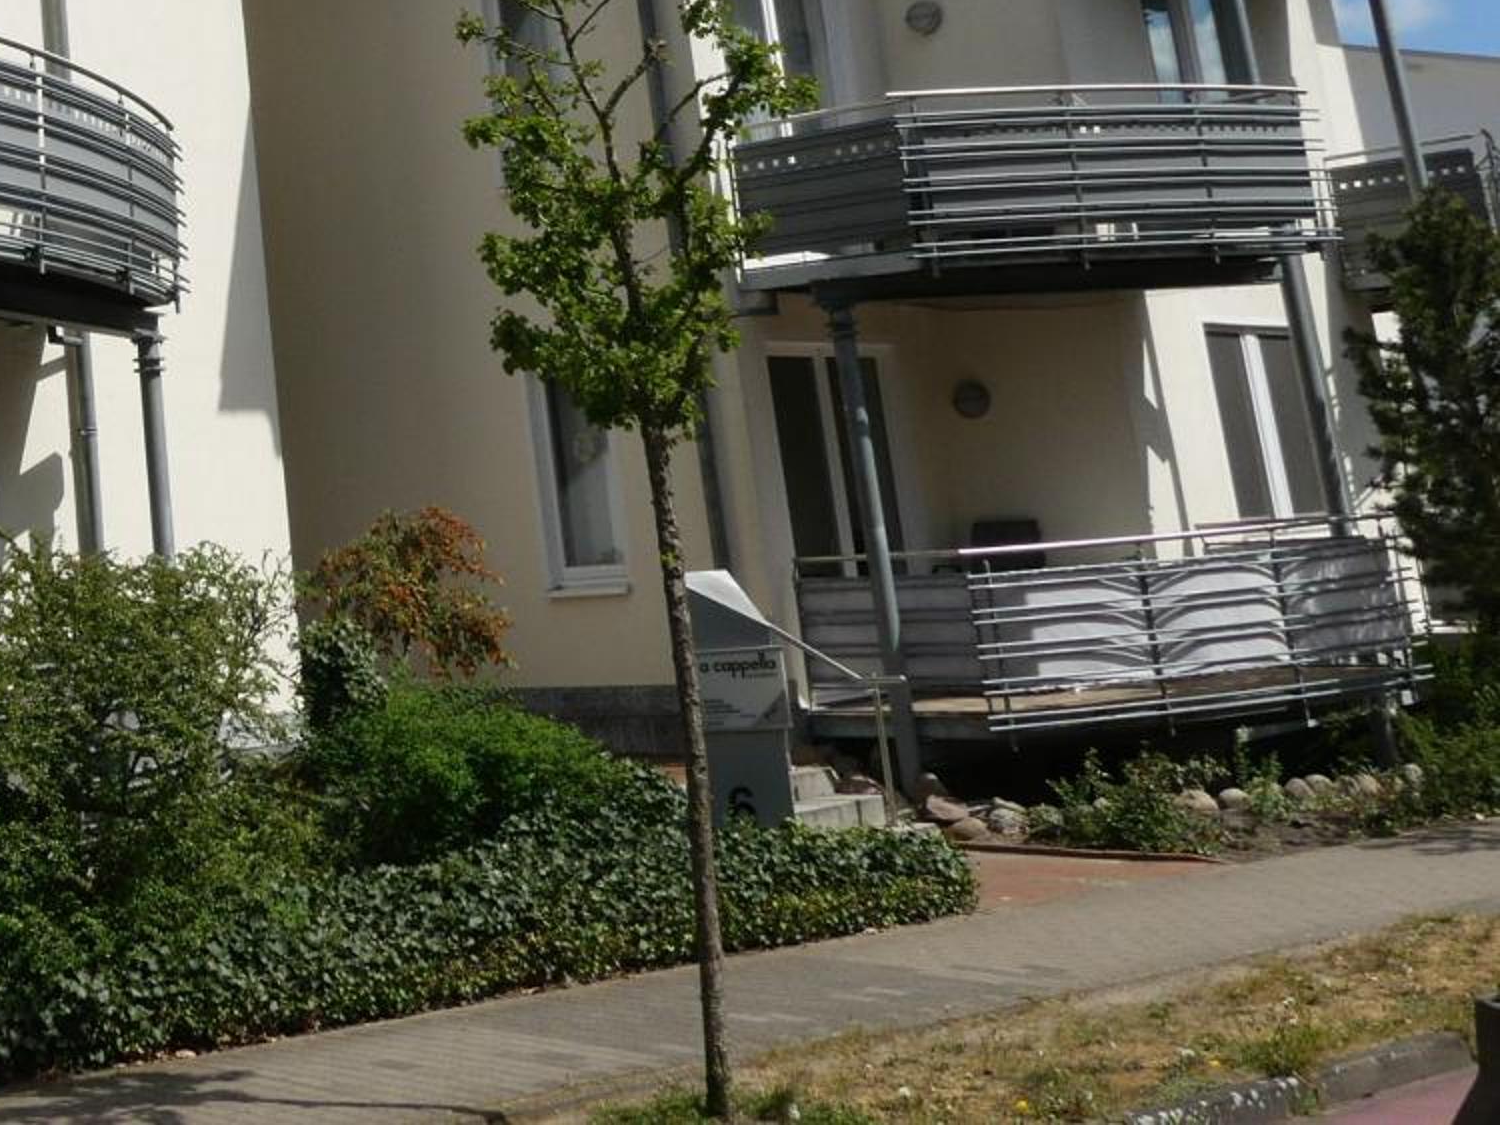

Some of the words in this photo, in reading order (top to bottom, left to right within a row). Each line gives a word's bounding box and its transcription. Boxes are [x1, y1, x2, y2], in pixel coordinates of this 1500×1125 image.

[700, 662, 709, 673] a
[714, 651, 777, 678] cappella
[728, 786, 757, 819] 6
